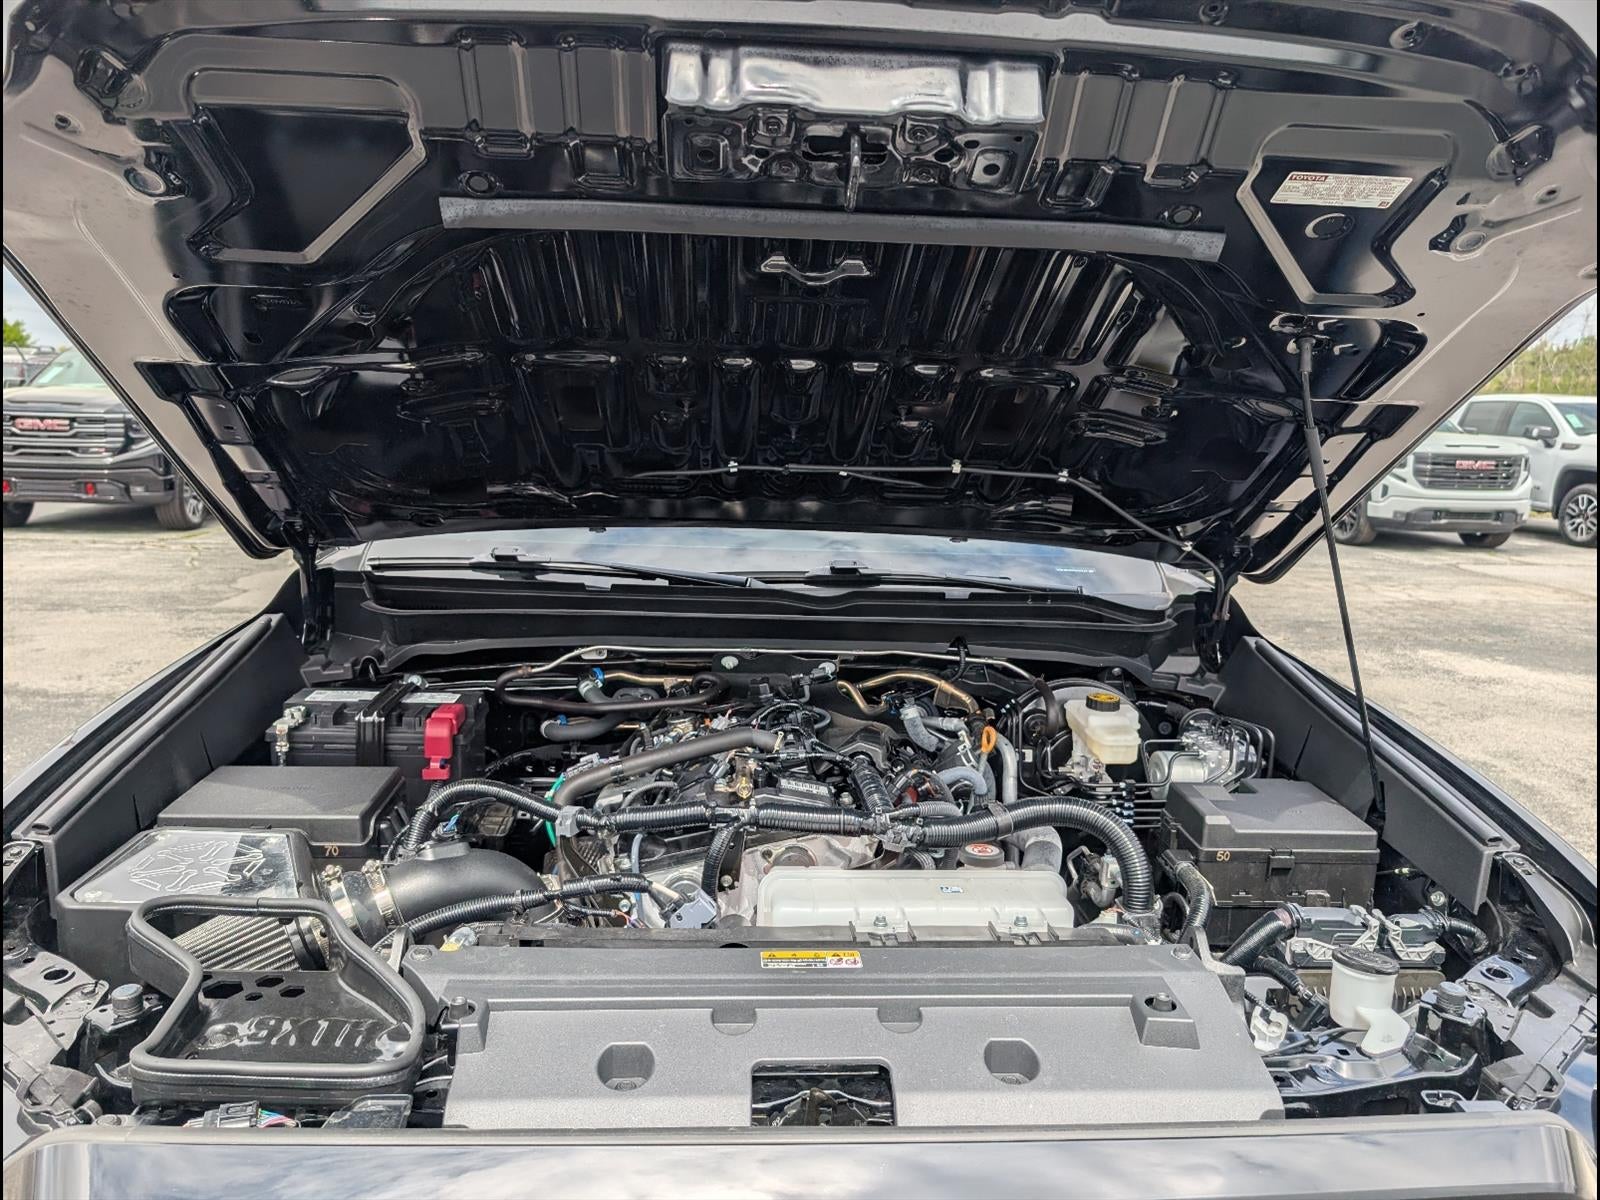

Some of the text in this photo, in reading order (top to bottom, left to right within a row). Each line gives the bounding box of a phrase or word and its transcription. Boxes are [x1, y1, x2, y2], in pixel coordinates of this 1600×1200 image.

[14, 418, 71, 431] GMC
[1455, 459, 1497, 471] GMC
[324, 844, 339, 857] 70
[1216, 850, 1231, 862] 50
